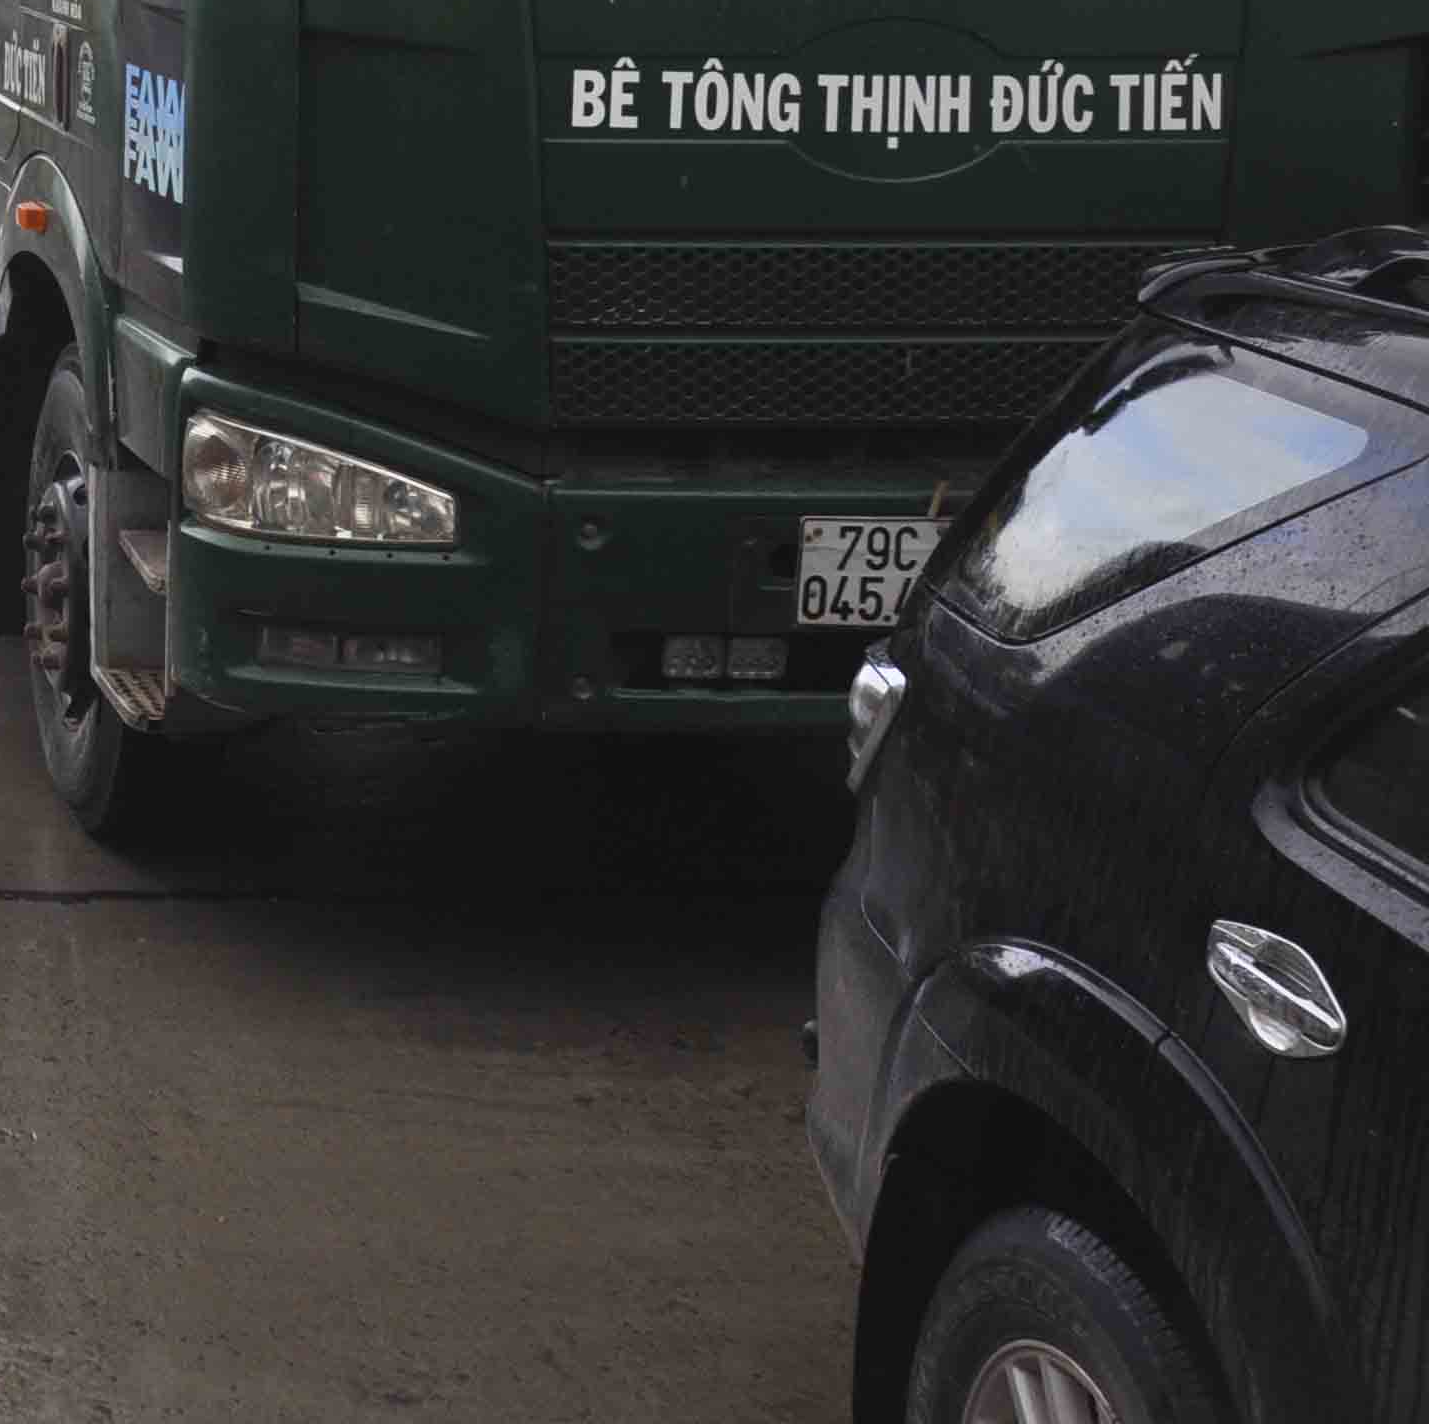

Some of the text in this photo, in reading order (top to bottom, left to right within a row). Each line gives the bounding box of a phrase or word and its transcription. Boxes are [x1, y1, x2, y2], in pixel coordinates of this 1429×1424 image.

[570, 53, 1223, 150] BÊ TÔNG THỊNH ĐỨC TIẾN
[837, 526, 919, 572] 79C
